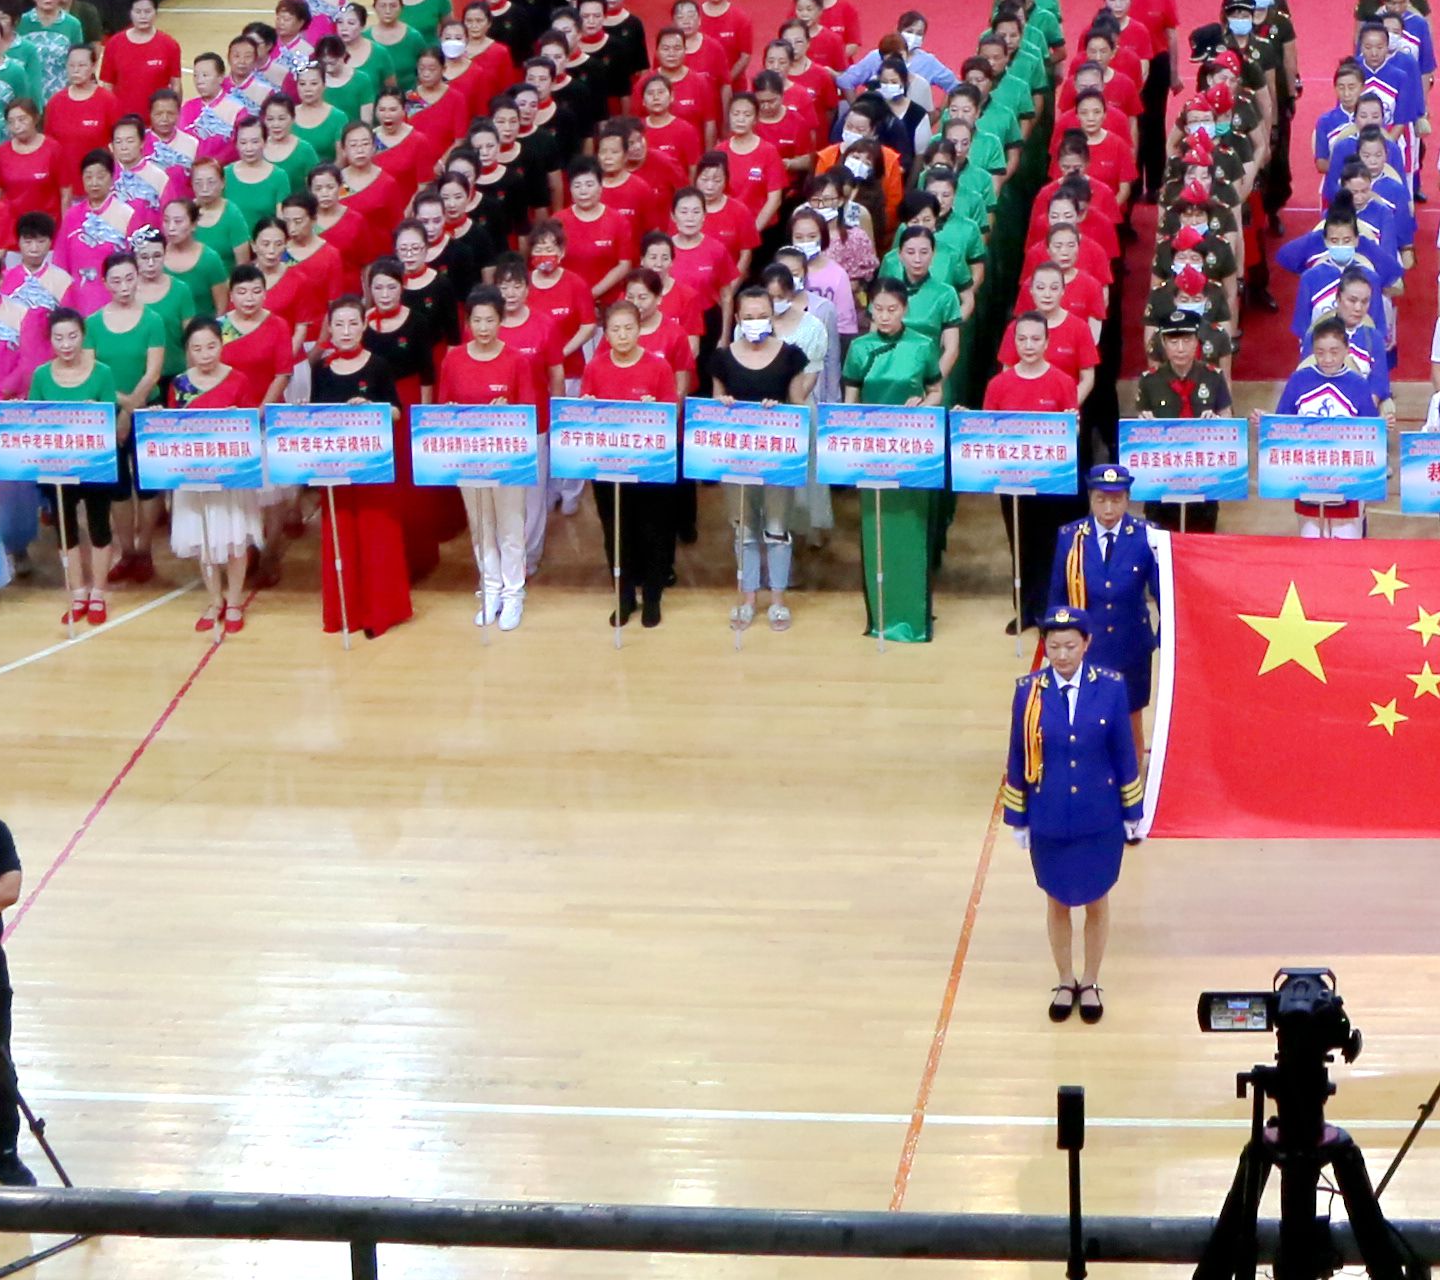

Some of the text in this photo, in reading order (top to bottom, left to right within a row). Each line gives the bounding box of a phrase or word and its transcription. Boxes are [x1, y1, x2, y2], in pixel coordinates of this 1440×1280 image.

[827, 436, 934, 454] 济宁市旗袍文化协会
